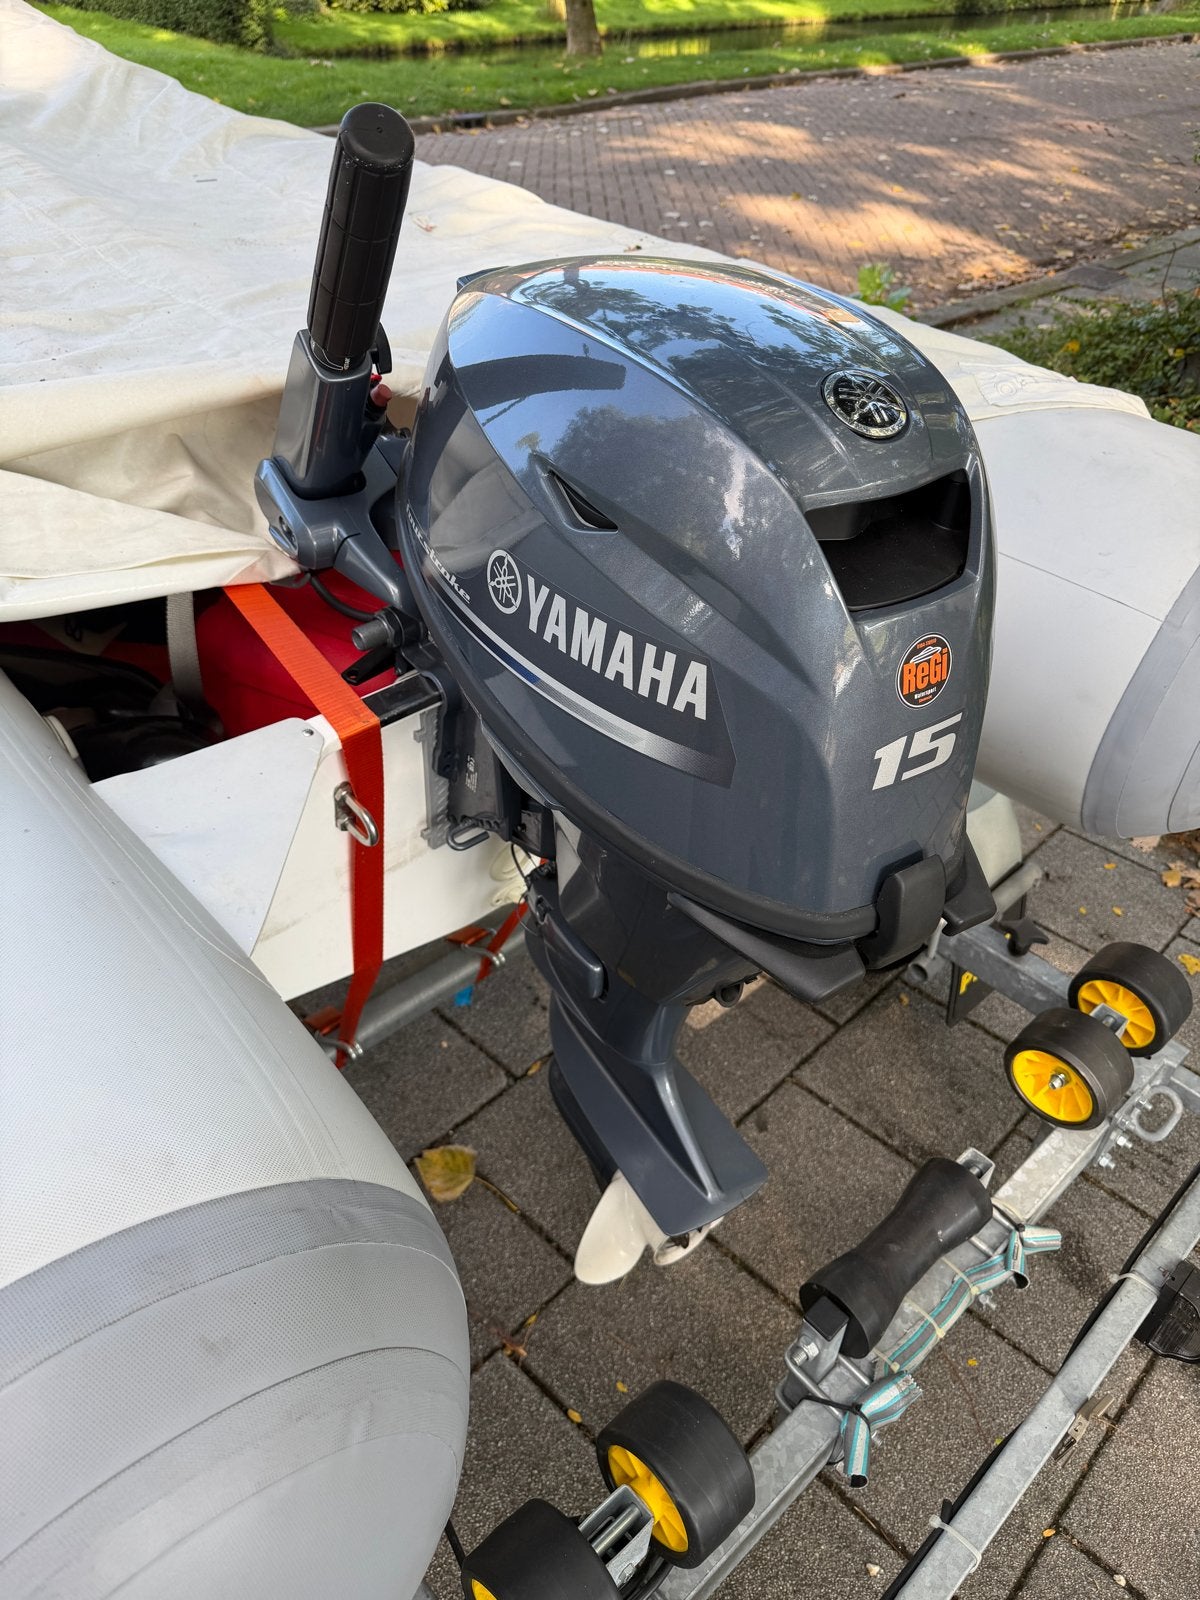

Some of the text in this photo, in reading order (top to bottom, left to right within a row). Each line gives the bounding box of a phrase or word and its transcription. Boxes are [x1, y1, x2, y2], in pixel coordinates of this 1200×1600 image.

[527, 574, 708, 721] YAMAHA
[903, 647, 948, 695] ReGi
[872, 712, 963, 791] 15
